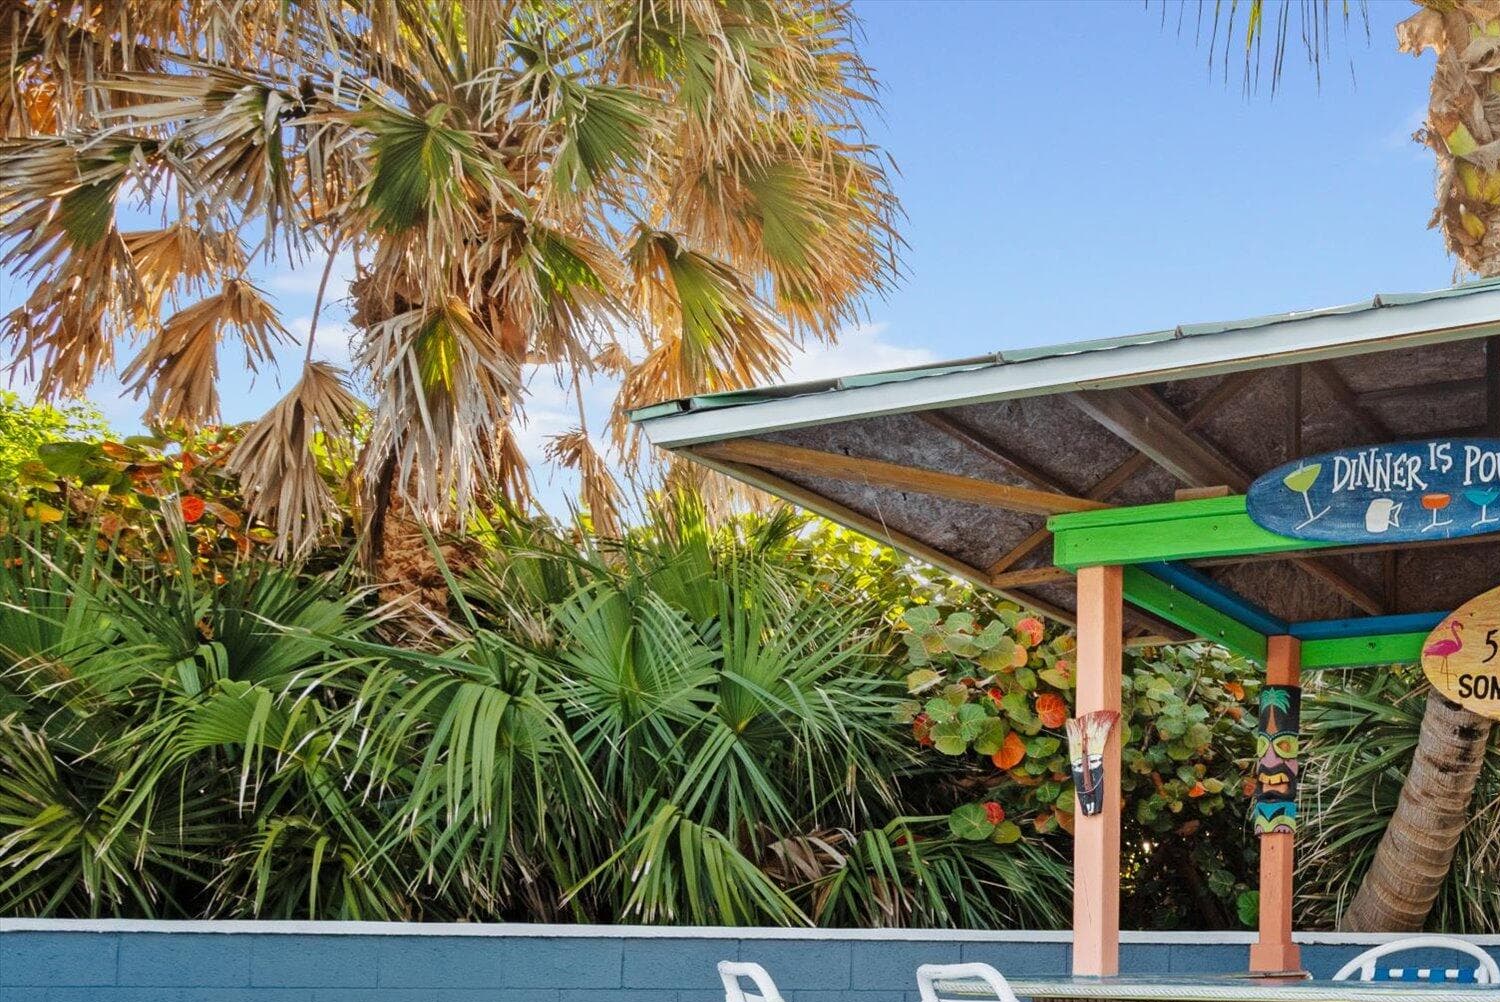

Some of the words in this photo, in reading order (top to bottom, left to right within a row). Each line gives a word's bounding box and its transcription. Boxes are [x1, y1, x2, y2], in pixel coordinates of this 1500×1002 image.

[1332, 448, 1428, 493] DINNER
[1428, 442, 1453, 474] IS
[1482, 629, 1499, 663] 5
